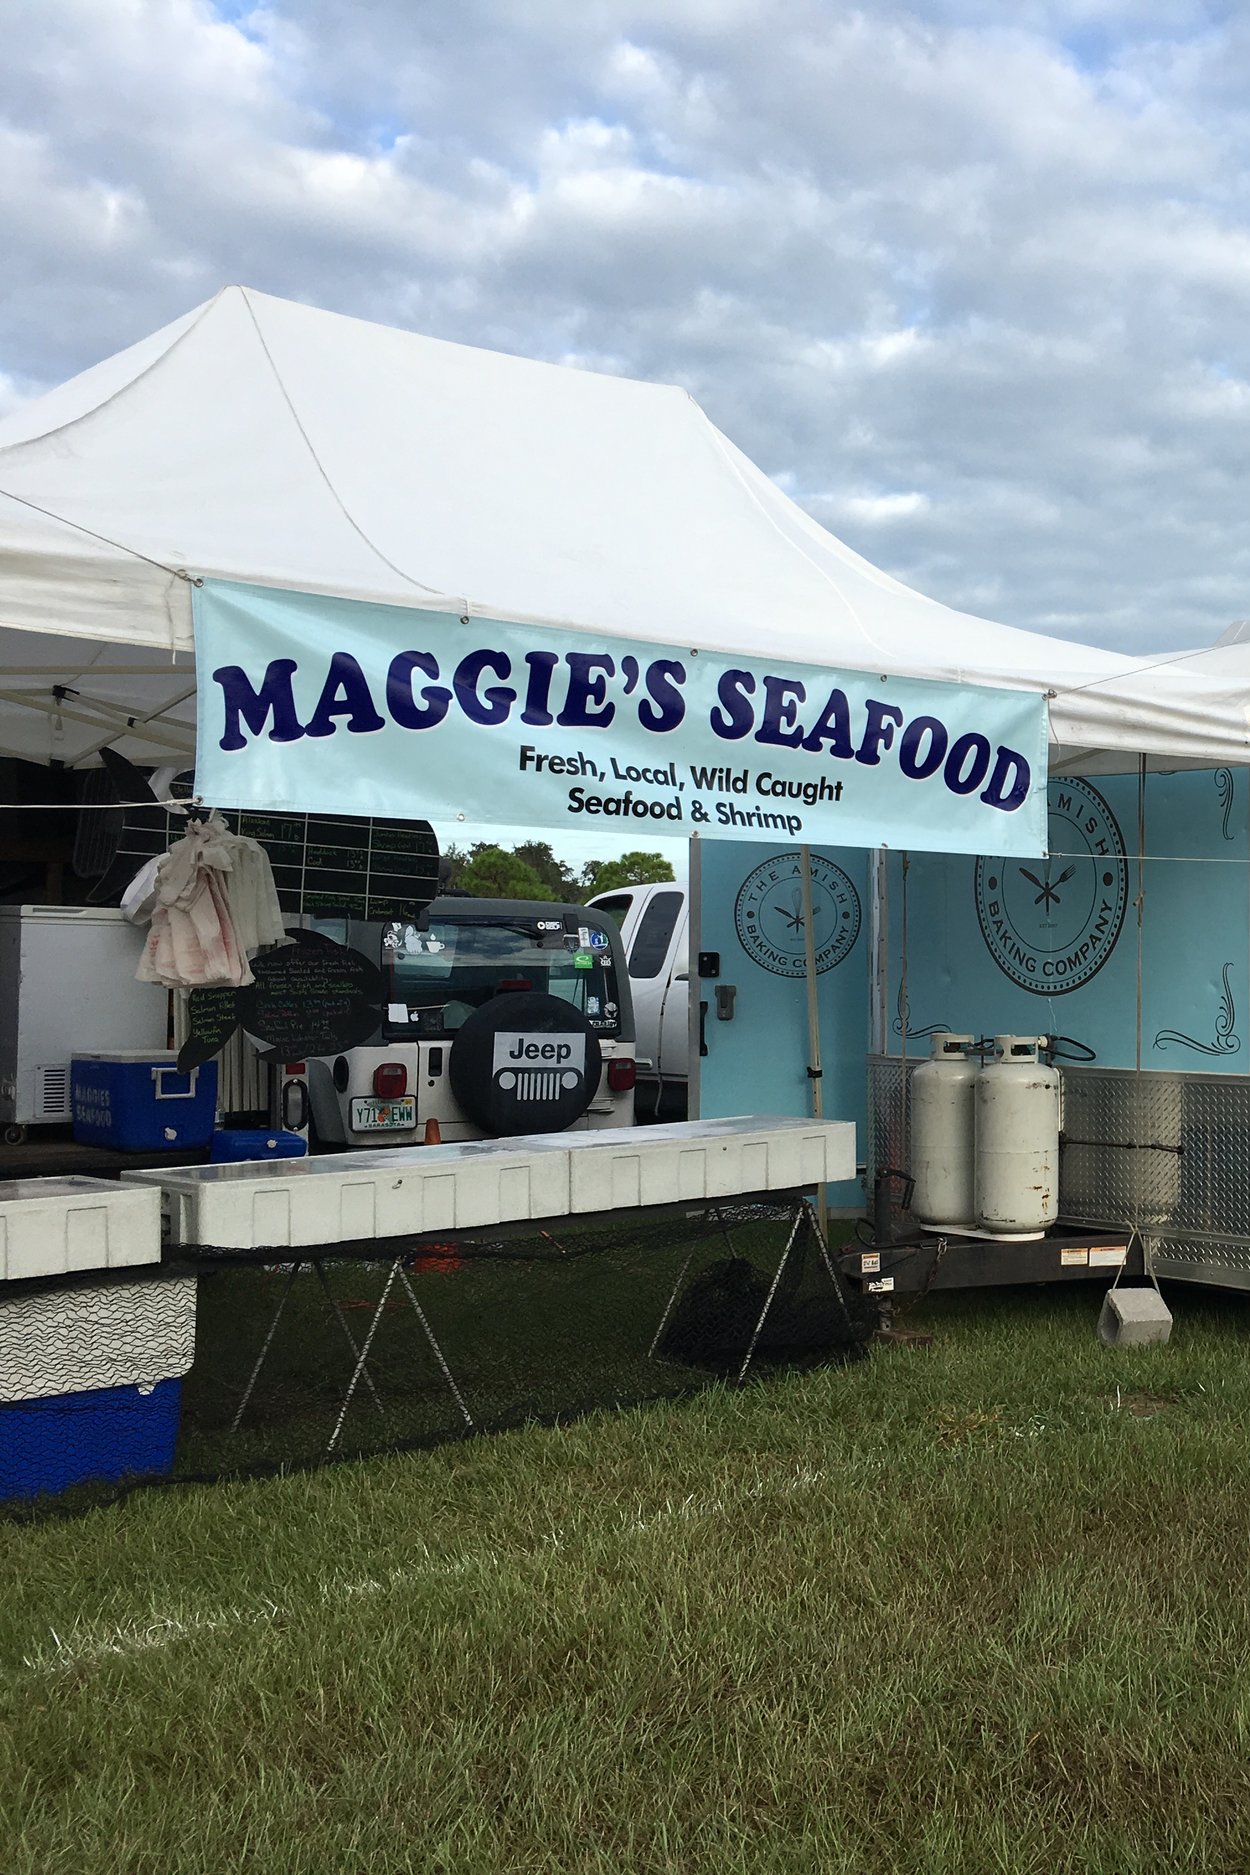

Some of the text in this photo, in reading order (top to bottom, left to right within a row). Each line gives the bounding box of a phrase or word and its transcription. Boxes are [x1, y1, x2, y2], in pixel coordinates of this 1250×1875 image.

[213, 648, 1032, 812] MAGGIE'S SEAFOOD
[519, 744, 844, 806] Fresh, Local, Wild Caught
[567, 786, 802, 836] Seafood & Shrimp
[1046, 793, 1109, 857] MISH
[748, 865, 848, 904] THE AMISH
[746, 924, 788, 966] BAKING
[987, 898, 1112, 977] BAKING COMPANY
[509, 1037, 571, 1065] Jeep
[357, 1105, 412, 1124] Y71 EWW
